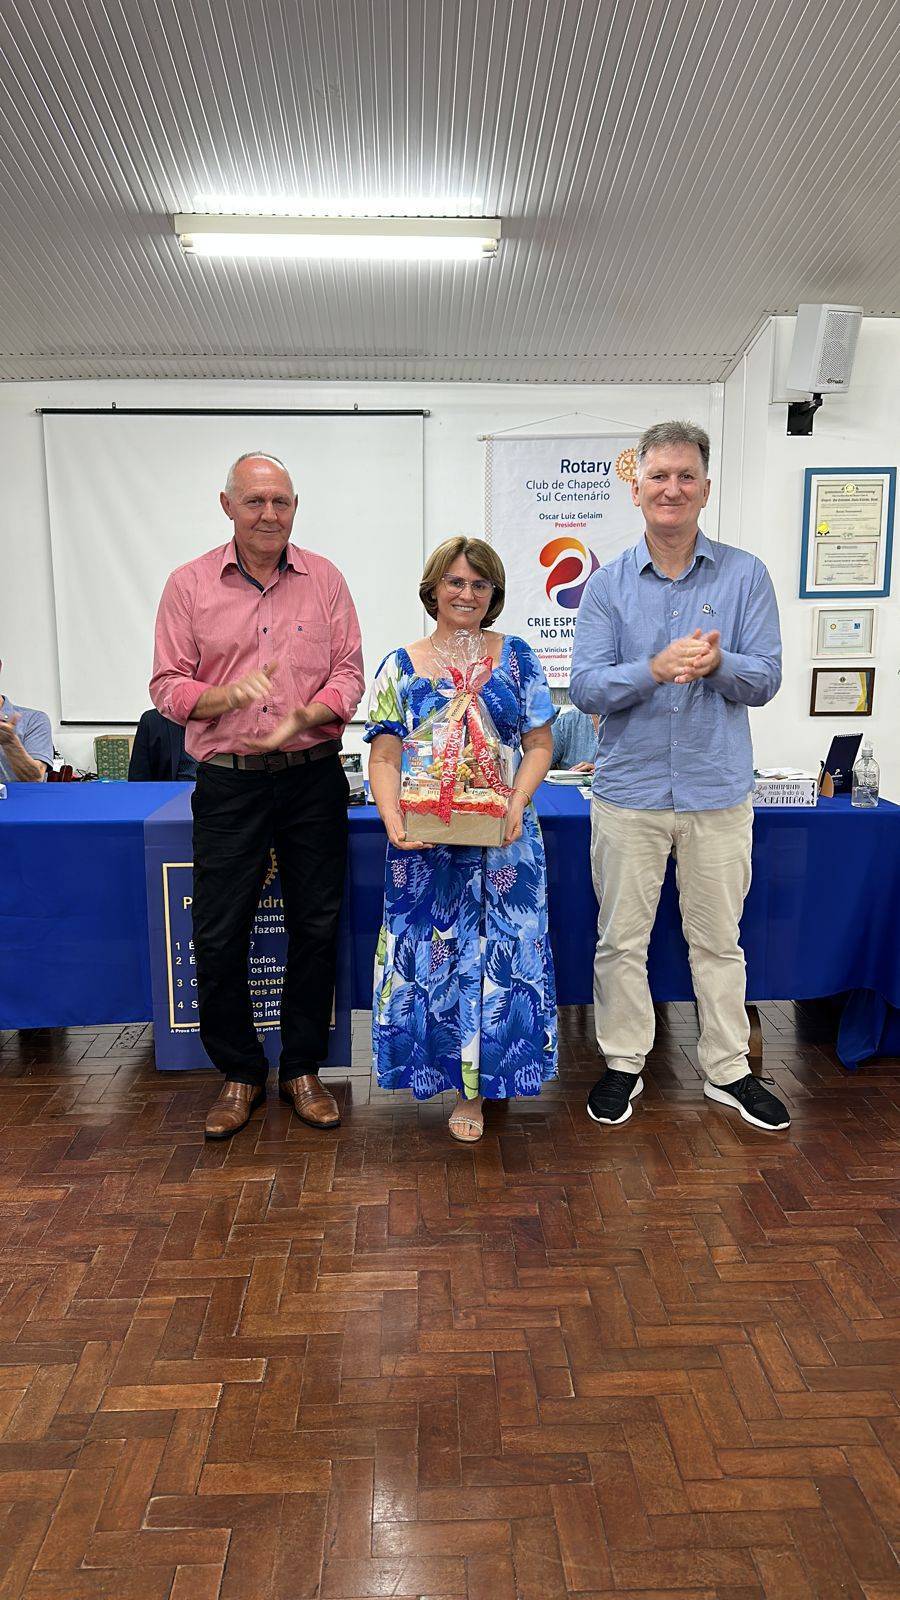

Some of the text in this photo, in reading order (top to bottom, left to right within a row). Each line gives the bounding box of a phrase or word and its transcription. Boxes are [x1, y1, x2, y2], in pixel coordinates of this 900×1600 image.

[560, 458, 612, 476] Rotary
[526, 478, 611, 491] Club de Chapecó
[536, 490, 610, 502] Sul Centenário
[538, 511, 603, 520] Oscar Luiz Gelaim
[527, 617, 551, 627] CRIE
[540, 629, 558, 638] NO
[253, 925, 285, 934] fazem
[175, 942, 181, 951] 1
[175, 956, 182, 965] 2
[250, 956, 276, 964] todos
[176, 978, 183, 987] 3
[250, 988, 268, 996] res
[177, 1001, 184, 1009] 4
[265, 1000, 281, 1011] par
